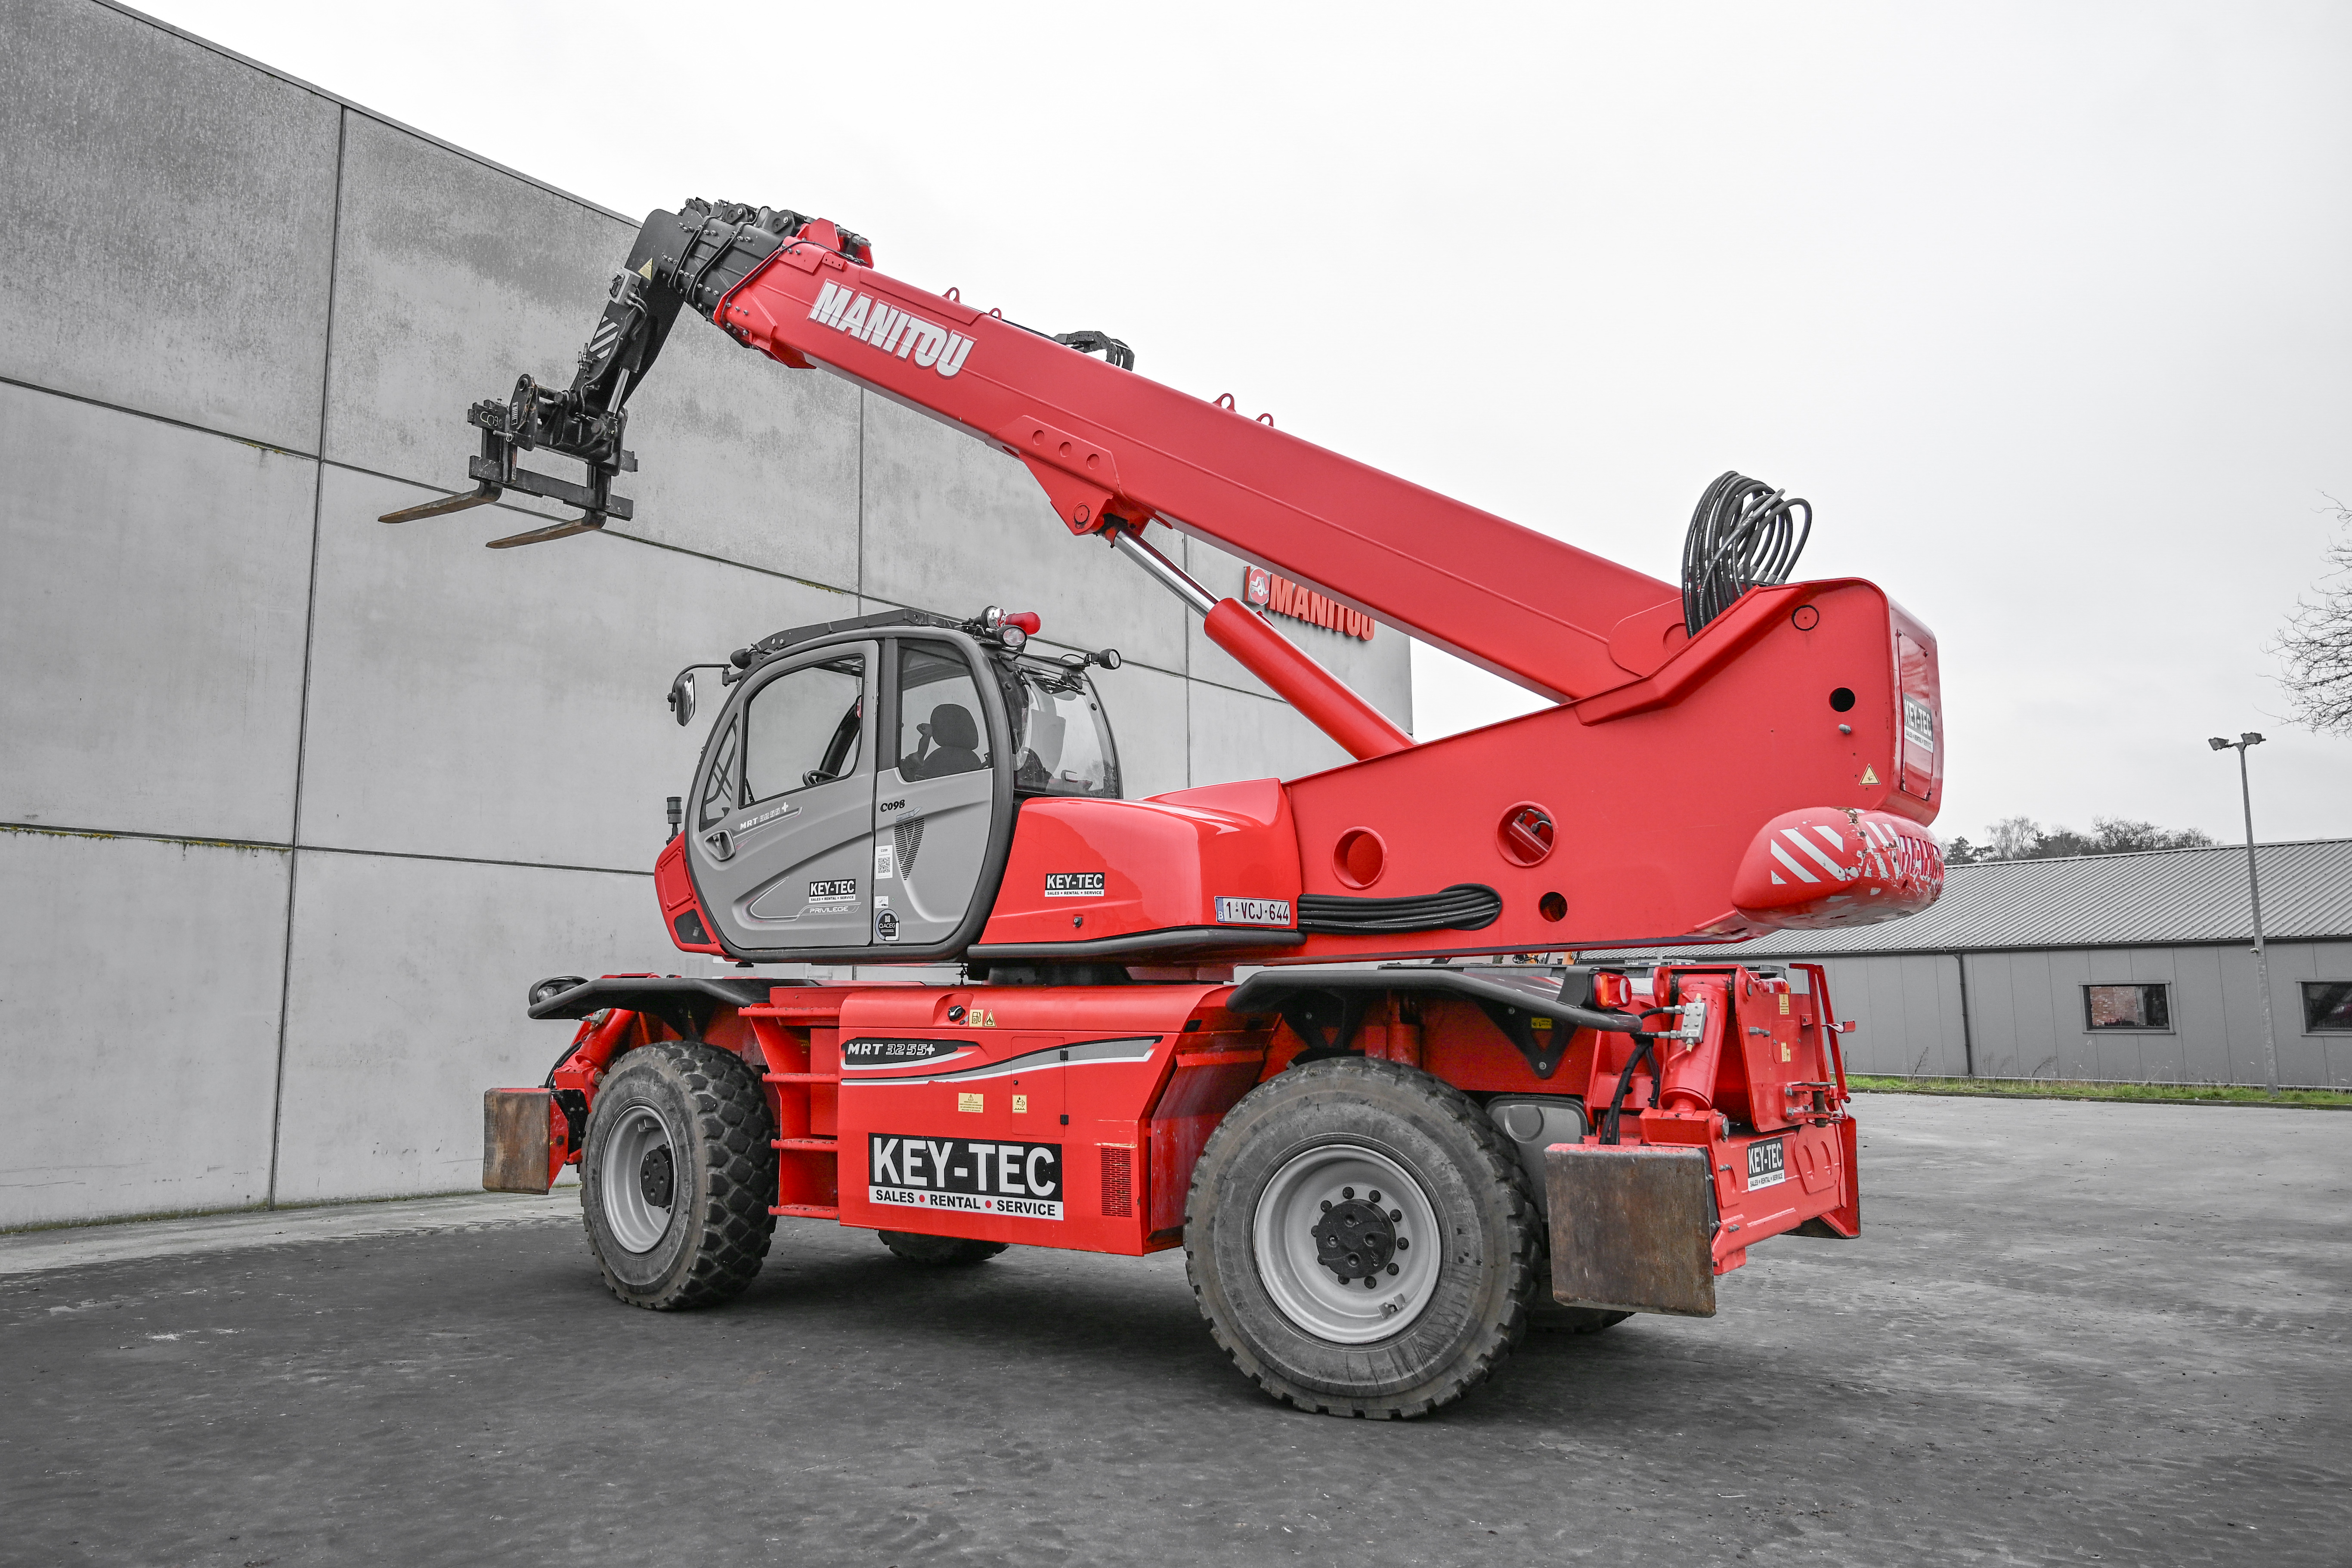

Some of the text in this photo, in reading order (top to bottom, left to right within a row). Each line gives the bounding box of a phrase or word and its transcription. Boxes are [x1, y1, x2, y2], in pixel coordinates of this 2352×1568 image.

[809, 281, 975, 377] MANITOU
[1269, 574, 1375, 640] MANITOU
[1904, 699, 1931, 736] KEY-TEC
[880, 799, 905, 812] C098
[740, 817, 758, 830] MRT
[811, 880, 854, 895] KEY-TEC
[1047, 874, 1103, 889] KEY-TEC
[1218, 911, 1223, 919] B
[848, 1043, 935, 1055] MRT 3255+
[873, 1137, 1056, 1197] KEY-TEC
[1748, 1143, 1782, 1174] KEY-TEC
[876, 1190, 1055, 1216] SALES RENTAL SERVICE
